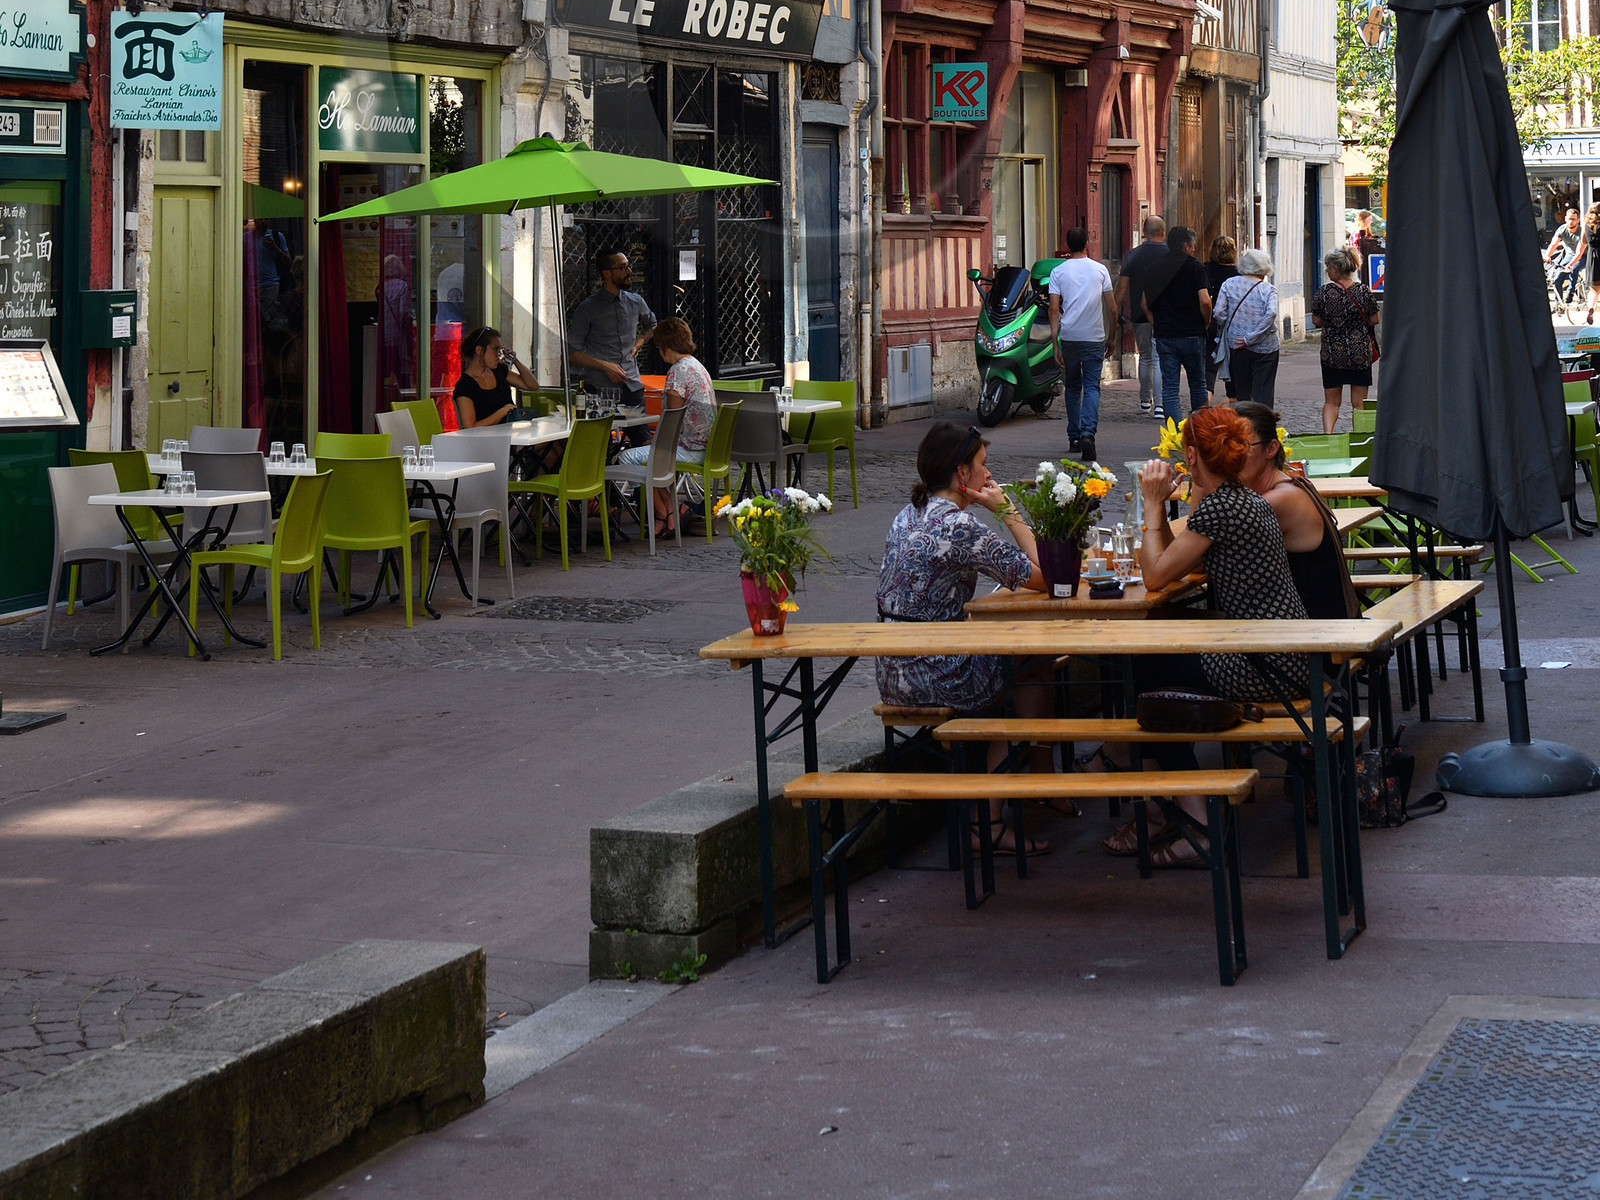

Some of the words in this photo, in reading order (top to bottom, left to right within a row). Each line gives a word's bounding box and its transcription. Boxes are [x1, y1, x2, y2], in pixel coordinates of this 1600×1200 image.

[10, 11, 64, 51] Lamian
[113, 82, 173, 95] Restaurant
[178, 83, 217, 97] Chinois
[141, 97, 184, 109] Lamian
[152, 110, 202, 122] Artisanales
[202, 110, 218, 122] Bio
[354, 90, 416, 134] Lamian
[933, 109, 986, 118] BOUTIQUES
